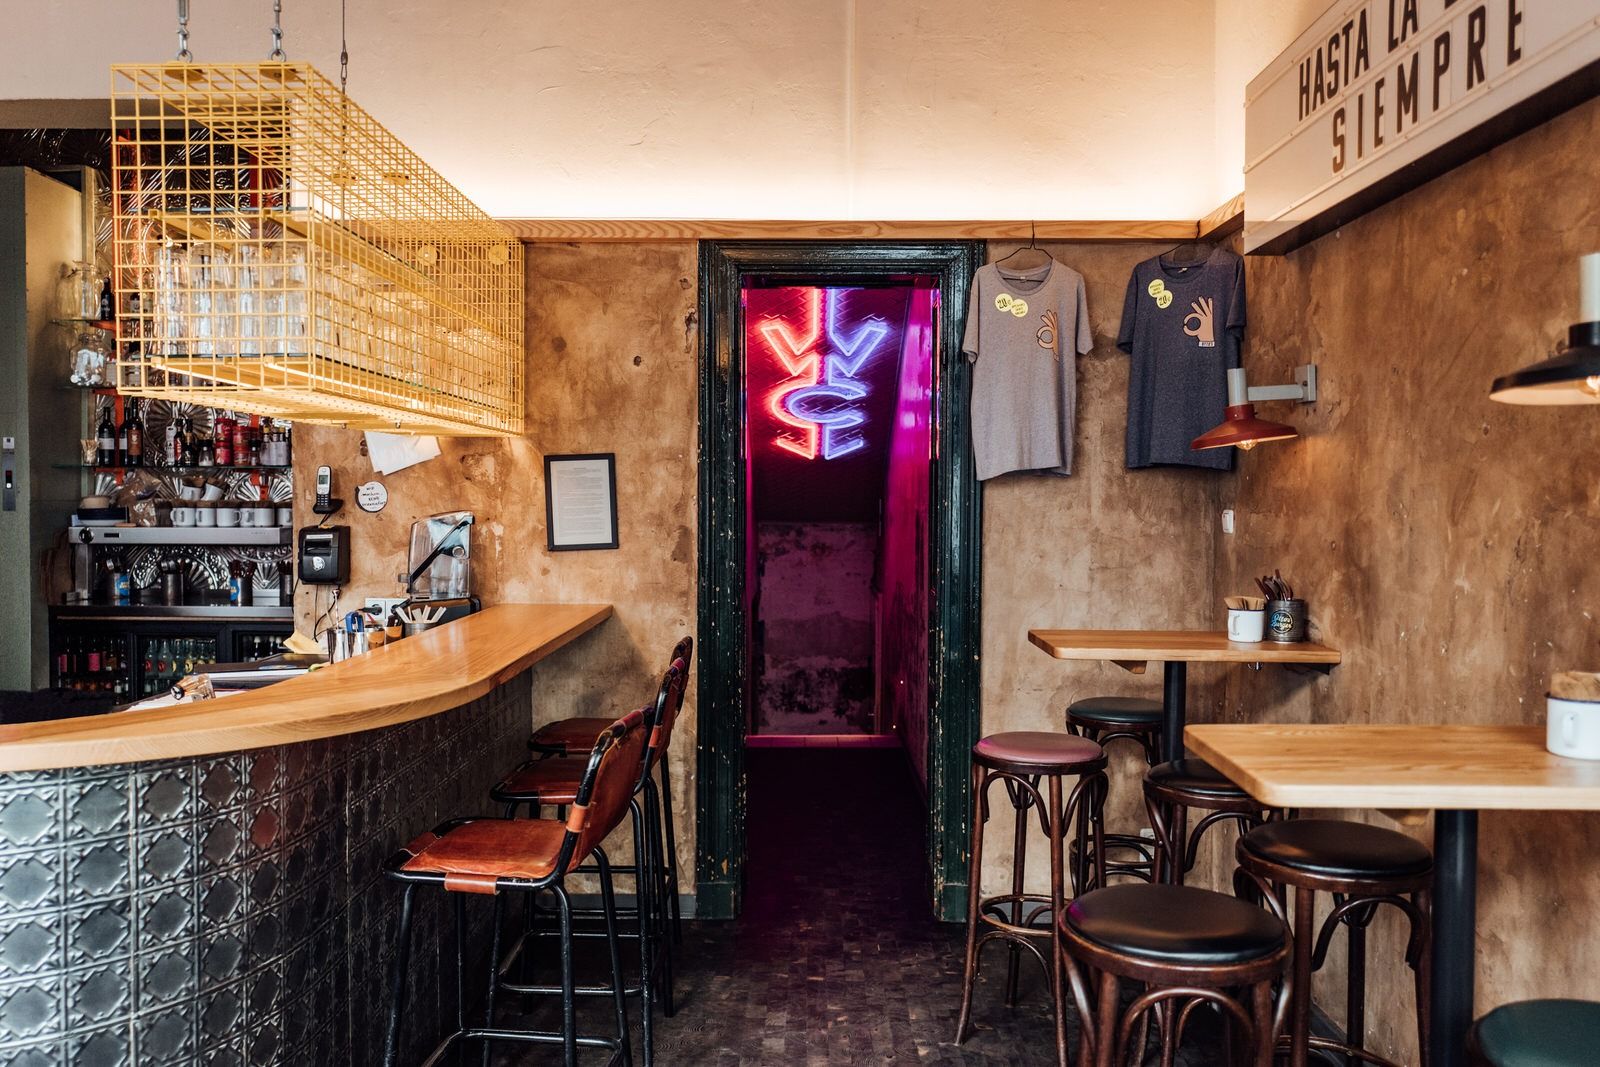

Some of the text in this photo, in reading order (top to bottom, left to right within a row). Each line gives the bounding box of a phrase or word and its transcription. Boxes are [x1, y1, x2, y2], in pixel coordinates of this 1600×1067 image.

[1299, 0, 1418, 122] HASTA LA
[1332, 0, 1522, 174] SIEMPRE
